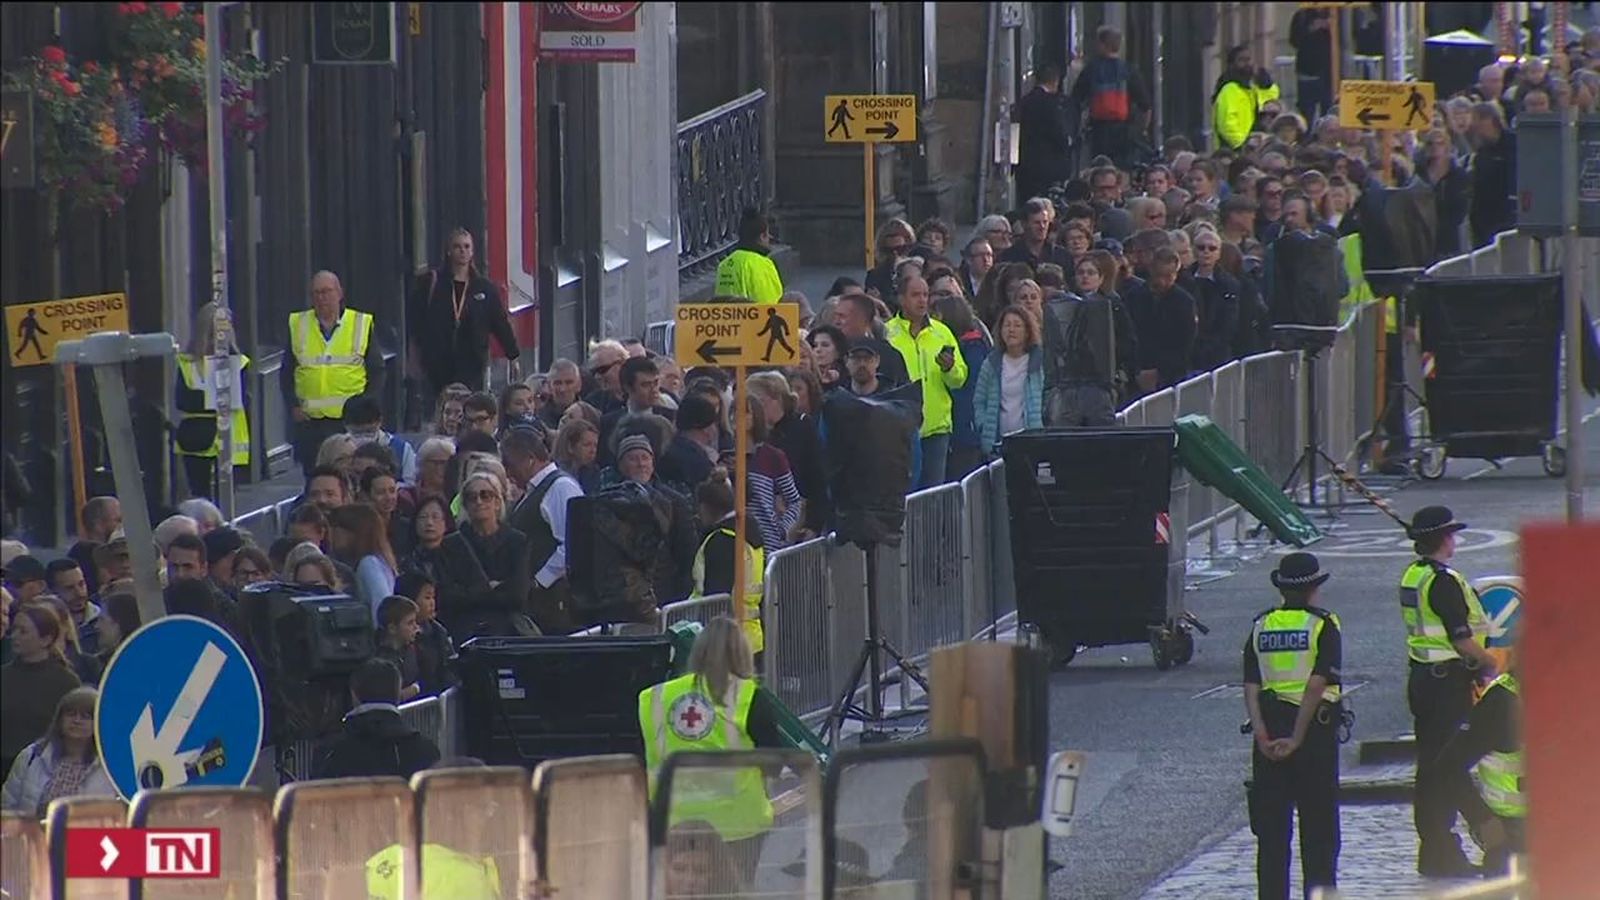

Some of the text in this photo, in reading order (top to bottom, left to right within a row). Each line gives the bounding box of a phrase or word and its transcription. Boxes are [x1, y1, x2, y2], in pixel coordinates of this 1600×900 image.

[576, 2, 621, 13] KEBABS
[571, 34, 605, 47] SOLD
[852, 98, 912, 109] CROSSING
[865, 110, 899, 120] POINT
[43, 298, 122, 317] CROSSING
[678, 307, 759, 320] CROSSING
[62, 315, 106, 331] POINT
[695, 324, 740, 337] POINT
[1260, 632, 1307, 650] POLICE
